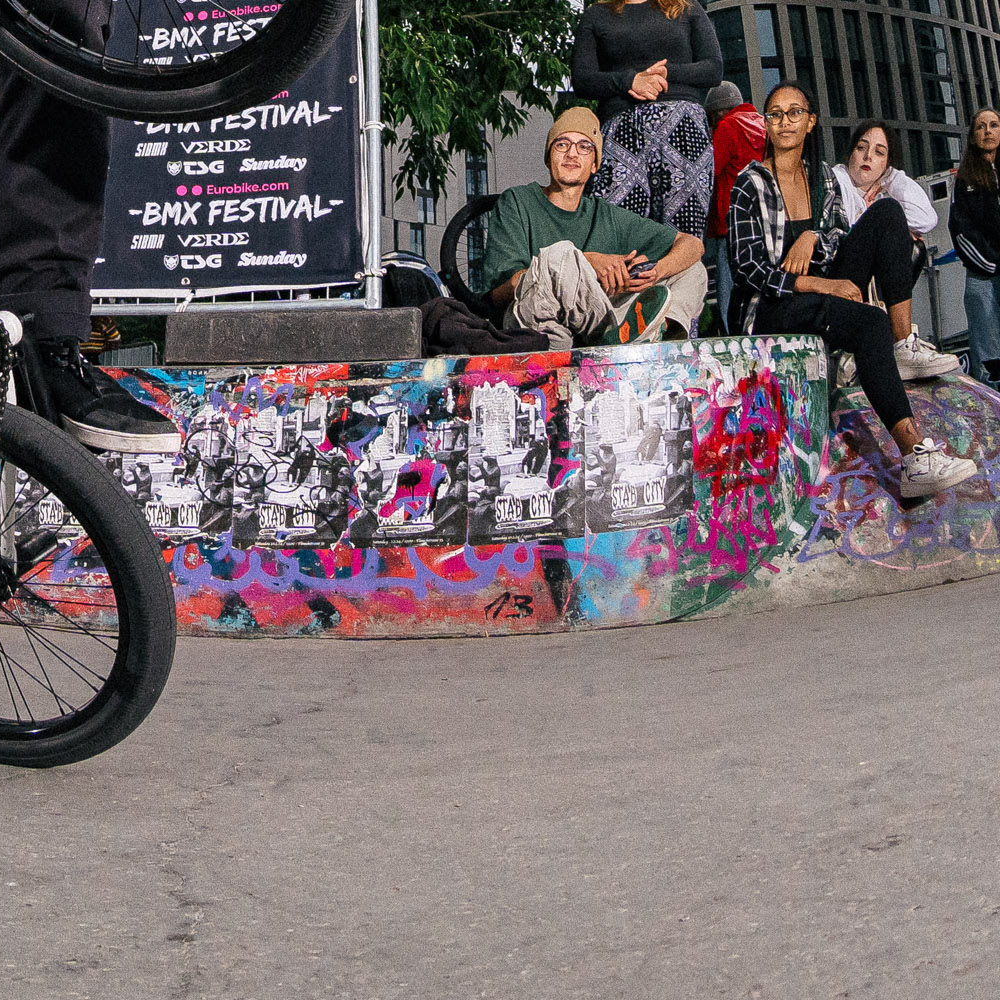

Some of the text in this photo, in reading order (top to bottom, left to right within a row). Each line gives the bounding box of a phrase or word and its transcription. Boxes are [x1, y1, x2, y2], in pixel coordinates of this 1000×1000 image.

[239, 155, 307, 172] Sunday
[206, 182, 289, 195] Eurobike.com
[237, 251, 308, 268] Sunday
